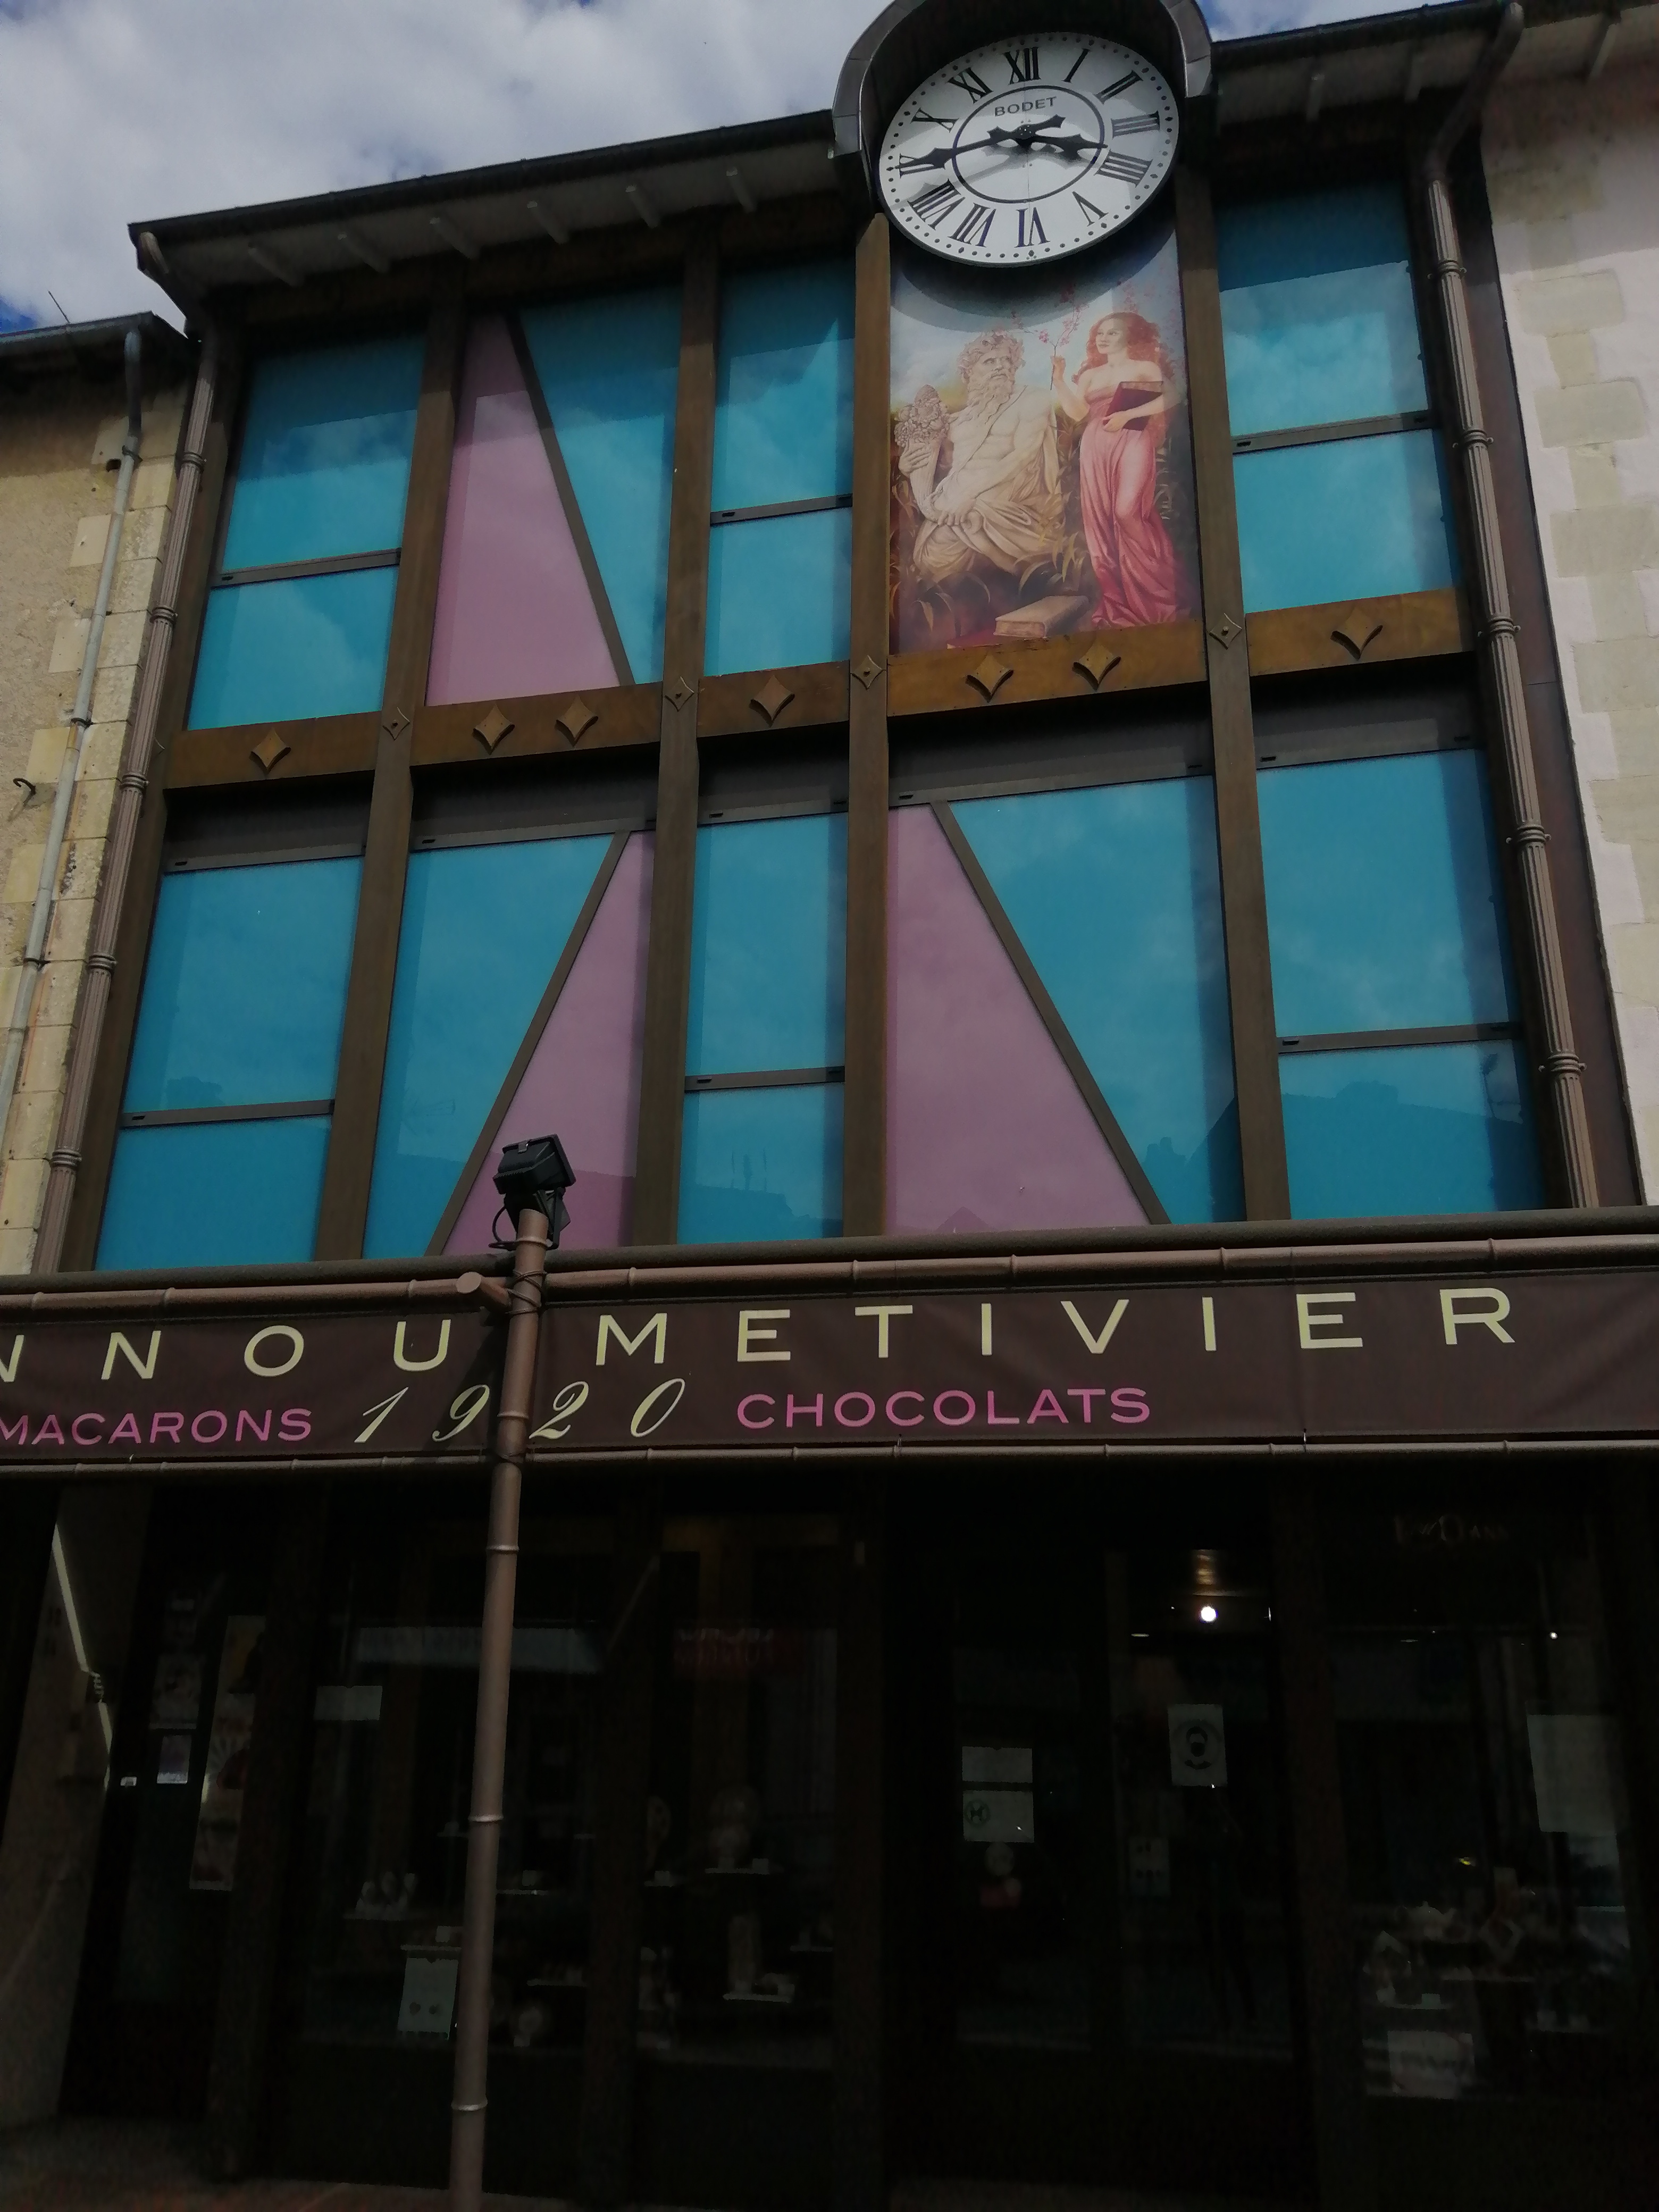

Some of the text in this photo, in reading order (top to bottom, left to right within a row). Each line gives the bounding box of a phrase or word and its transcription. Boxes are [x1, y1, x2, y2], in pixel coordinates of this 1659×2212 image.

[1004, 46, 1040, 84] XII
[994, 96, 1058, 116] BODET
[596, 1287, 1515, 1365] METIVIER
[0, 1409, 312, 1445] MACARONS
[354, 1378, 685, 1443] 1920
[737, 1388, 1150, 1429] CHOCOLATS
